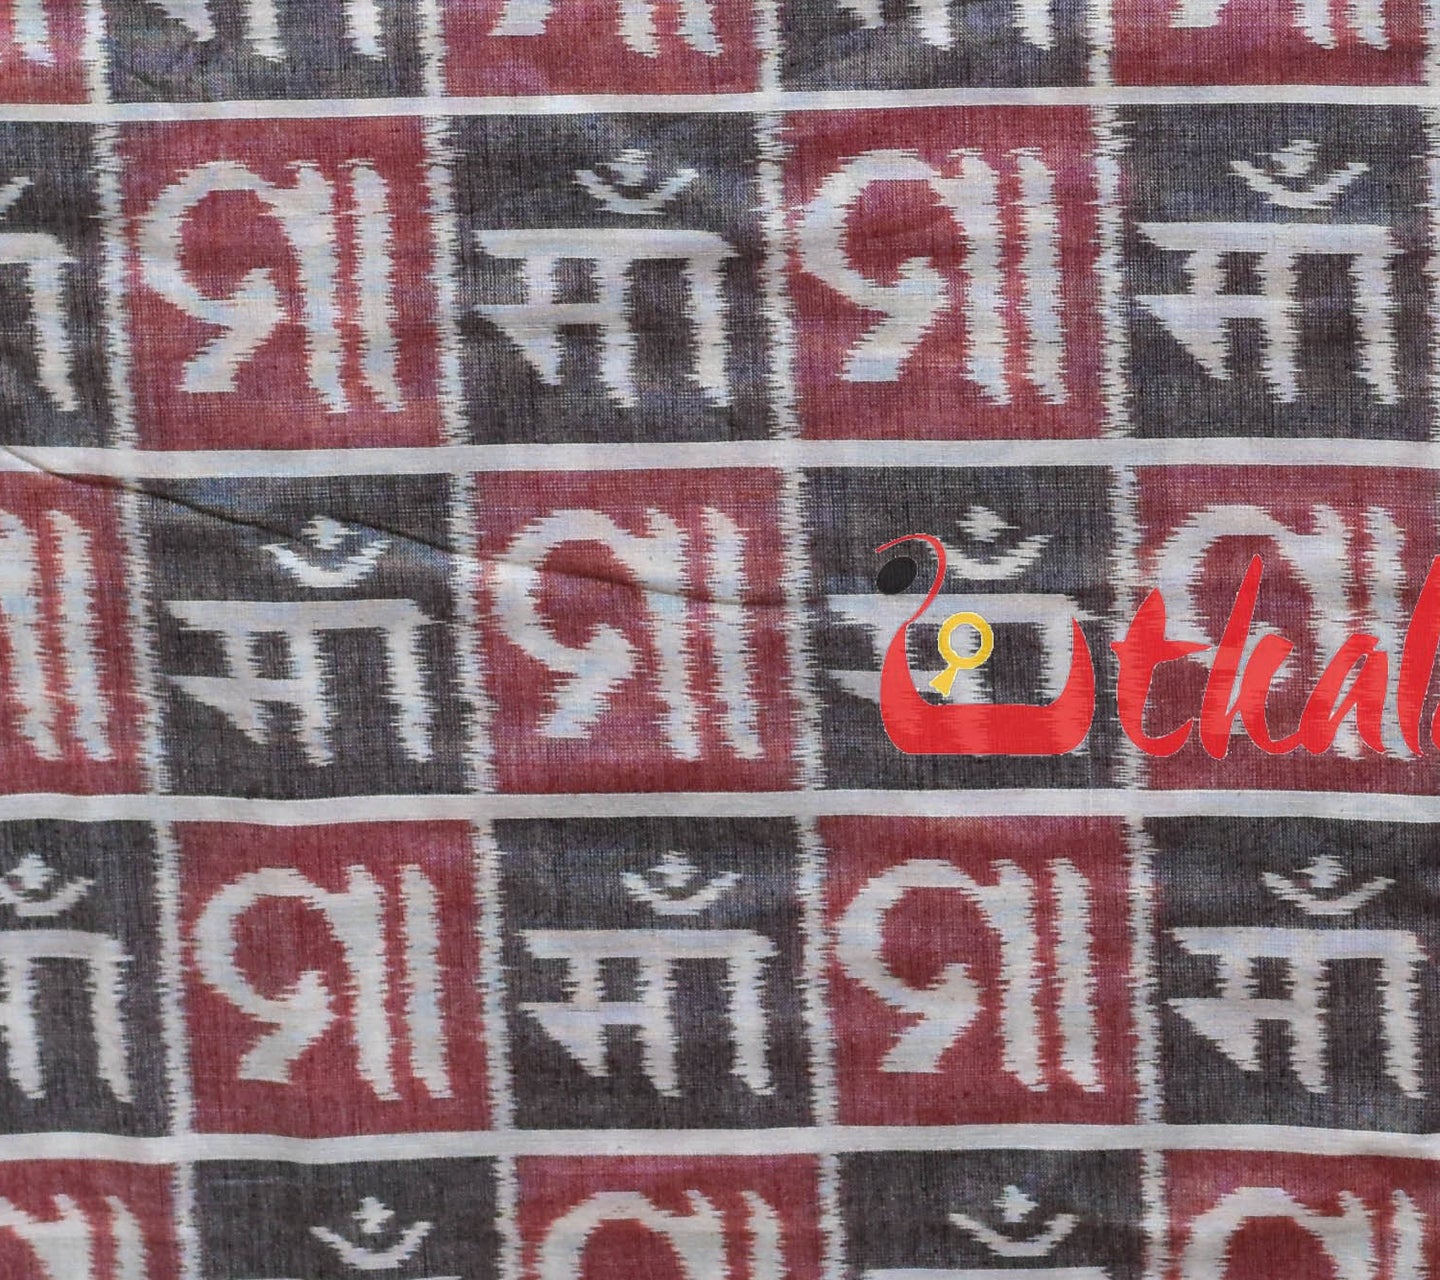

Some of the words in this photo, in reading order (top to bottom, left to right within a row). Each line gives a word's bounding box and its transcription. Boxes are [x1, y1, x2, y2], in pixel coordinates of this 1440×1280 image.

[475, 147, 732, 408] माँ
[1137, 139, 1400, 405] माँ
[168, 517, 433, 765] माँ
[1170, 856, 1425, 1099] माँ
